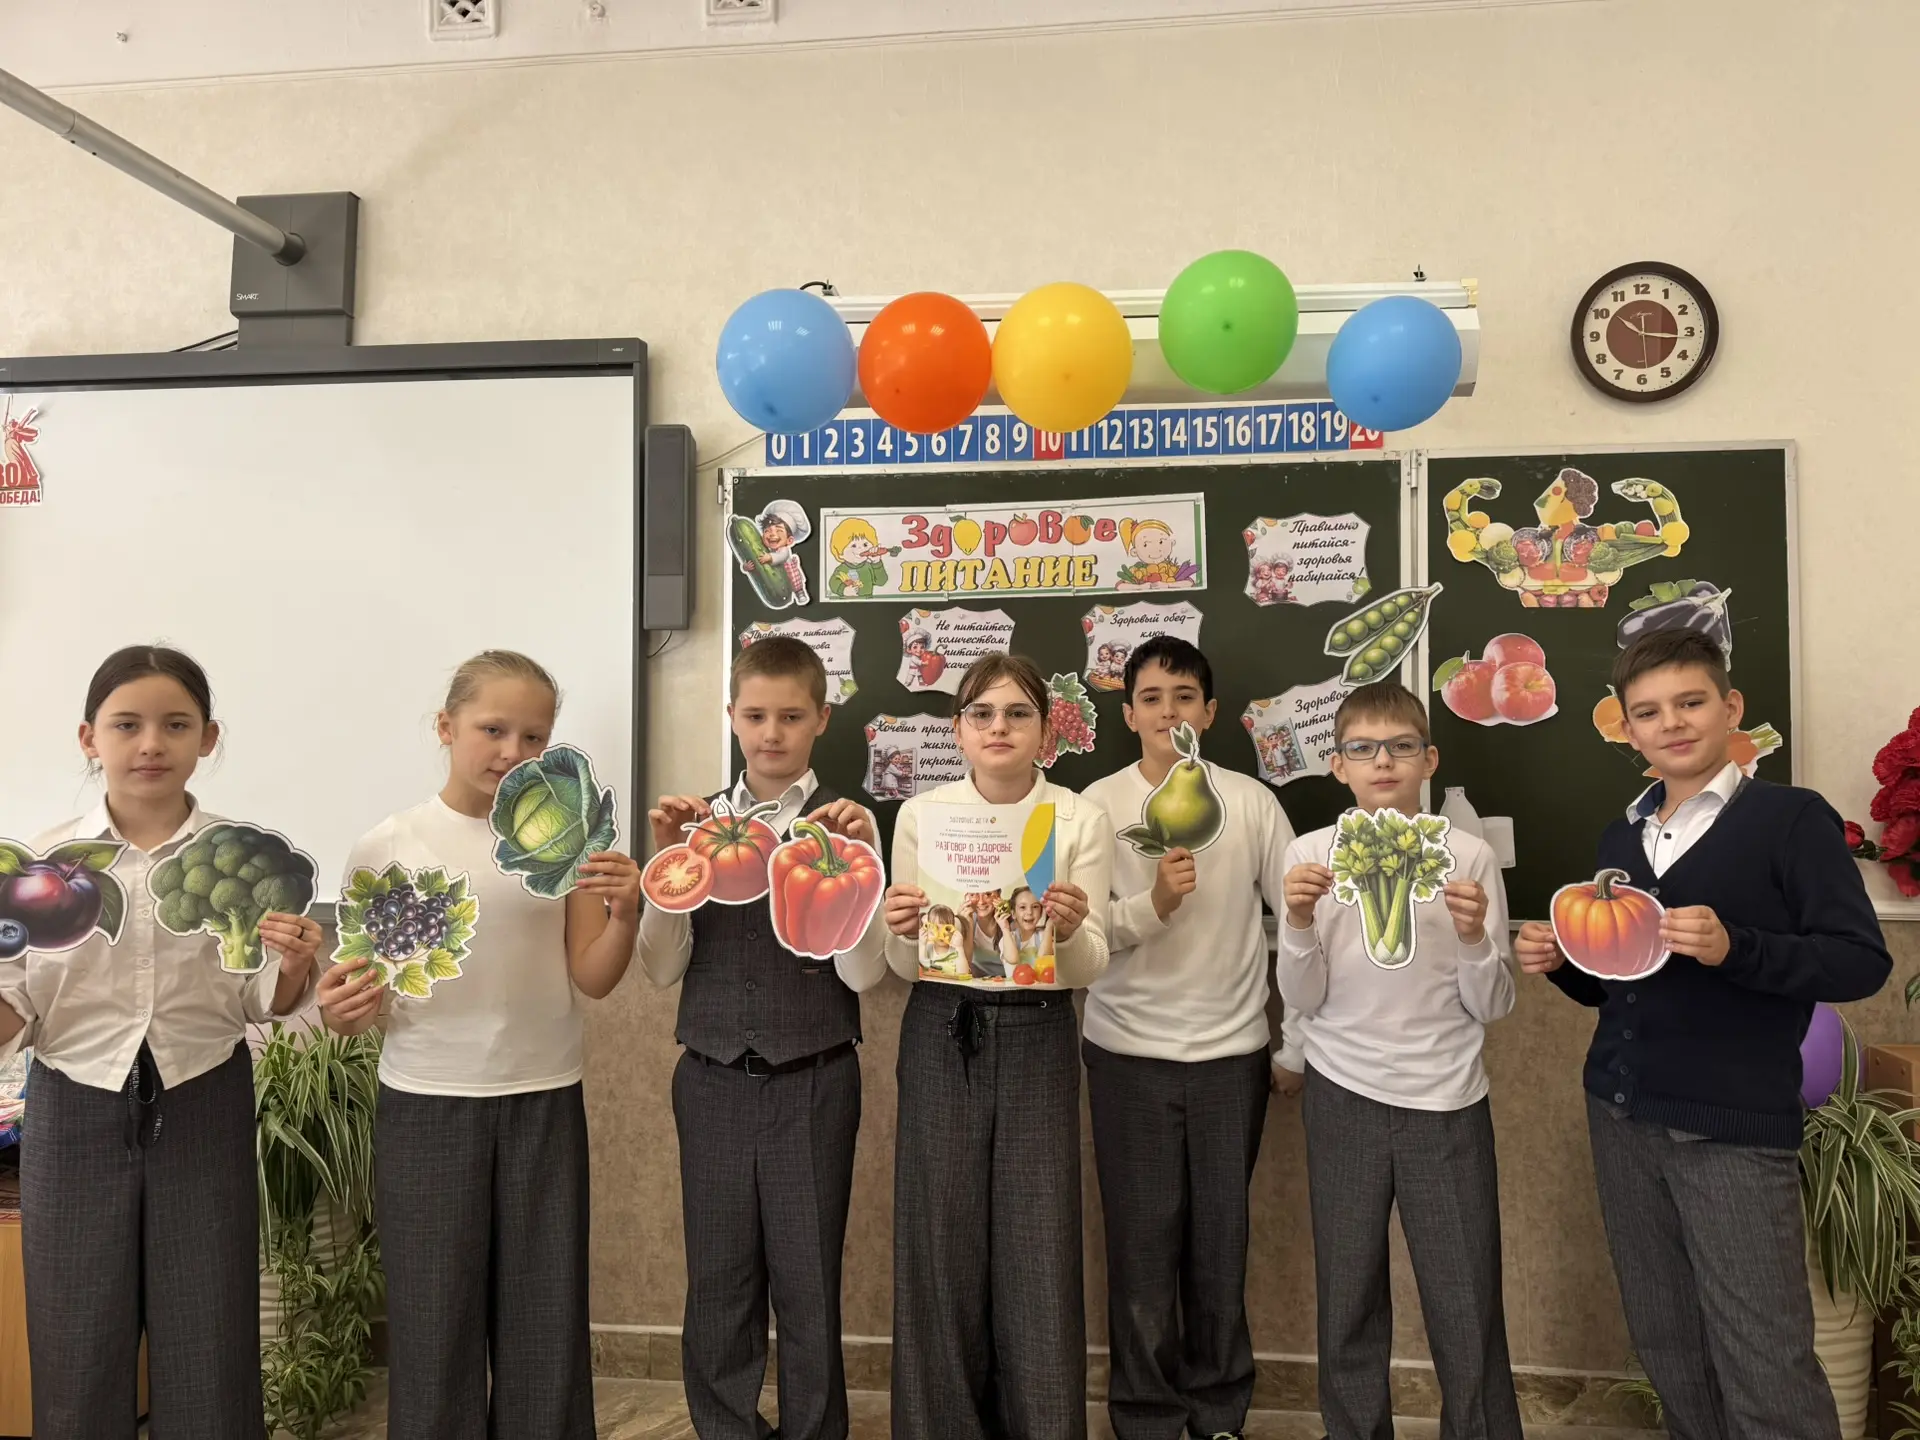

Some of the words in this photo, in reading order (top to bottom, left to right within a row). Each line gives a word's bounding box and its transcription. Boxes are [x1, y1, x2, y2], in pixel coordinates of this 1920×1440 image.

[1633, 284, 1651, 295] 12
[1662, 288, 1670, 300] 1
[1611, 290, 1626, 302] 11
[1592, 308, 1610, 320] 10
[1678, 304, 1689, 315] 2
[1589, 331, 1600, 342] 9
[1684, 326, 1695, 338] 3
[1595, 353, 1607, 365] 8
[1677, 349, 1689, 361] 4
[1613, 369, 1624, 380] 7
[1660, 367, 1672, 378] 5
[1636, 374, 1648, 385] 6
[771, 434, 787, 460] 0
[799, 433, 810, 459] 1
[824, 427, 839, 459] 2
[851, 427, 865, 458] 3
[877, 426, 893, 458] 4
[904, 432, 919, 457] 5
[931, 433, 947, 456] 6
[958, 424, 973, 455] 7
[985, 424, 1000, 454] 8
[1012, 422, 1028, 453] 9
[1040, 429, 1061, 452] 10
[1098, 418, 1123, 451] 12
[1129, 417, 1154, 450] 13
[1160, 416, 1188, 449] 14
[1192, 416, 1218, 448] 15
[1224, 414, 1251, 447] 16
[1256, 413, 1283, 446] 17
[1288, 411, 1316, 444] 18
[1321, 410, 1348, 443] 19
[0, 490, 41, 506] ОБЕДА!
[1289, 520, 1359, 536] Правильно
[1297, 553, 1352, 569] здоровья
[898, 554, 1098, 592] ПИТАНИЕ
[1287, 567, 1365, 585] набирайся!
[935, 620, 951, 631] Не
[953, 621, 1013, 632] питайтесь
[1110, 613, 1161, 627] Здоровый
[1294, 690, 1349, 714] Здоровое
[1294, 711, 1336, 730] питан
[874, 720, 917, 733] Хочешь
[921, 724, 956, 737] продл
[1304, 727, 1336, 746] здоро
[920, 741, 957, 750] жизнь
[919, 756, 963, 769] укроти
[935, 841, 967, 852] РАЗГОВОР
[969, 843, 974, 853] О
[977, 842, 1013, 853] ЗДОРОВЬЕ
[947, 853, 953, 863] И
[954, 853, 1000, 864] ПРАВИЛЬНОМ
[956, 865, 989, 876] ПИТАНИИ
